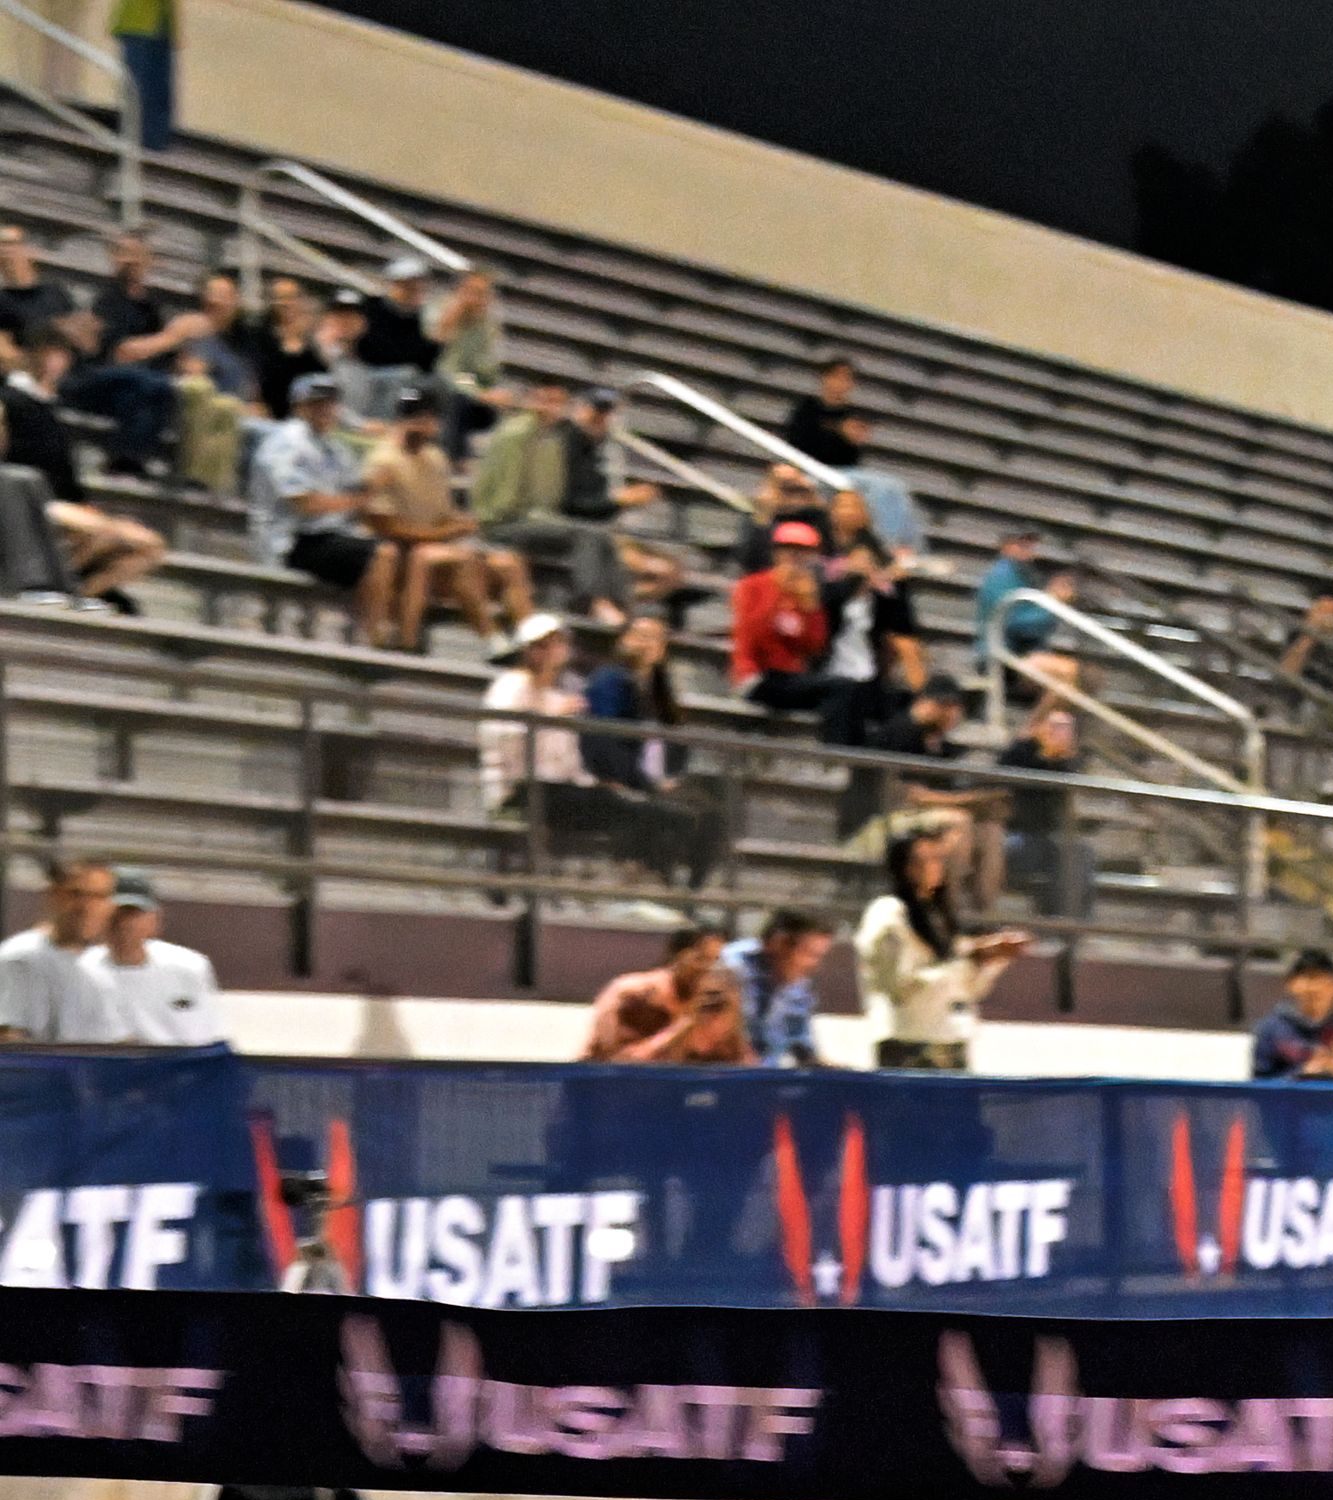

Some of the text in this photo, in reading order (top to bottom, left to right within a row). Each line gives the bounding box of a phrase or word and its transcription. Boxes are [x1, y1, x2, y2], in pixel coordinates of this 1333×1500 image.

[0, 1182, 203, 1290] ATF
[364, 1192, 645, 1304] USATF
[870, 1179, 1073, 1287] USATF
[484, 1380, 822, 1462] USATF
